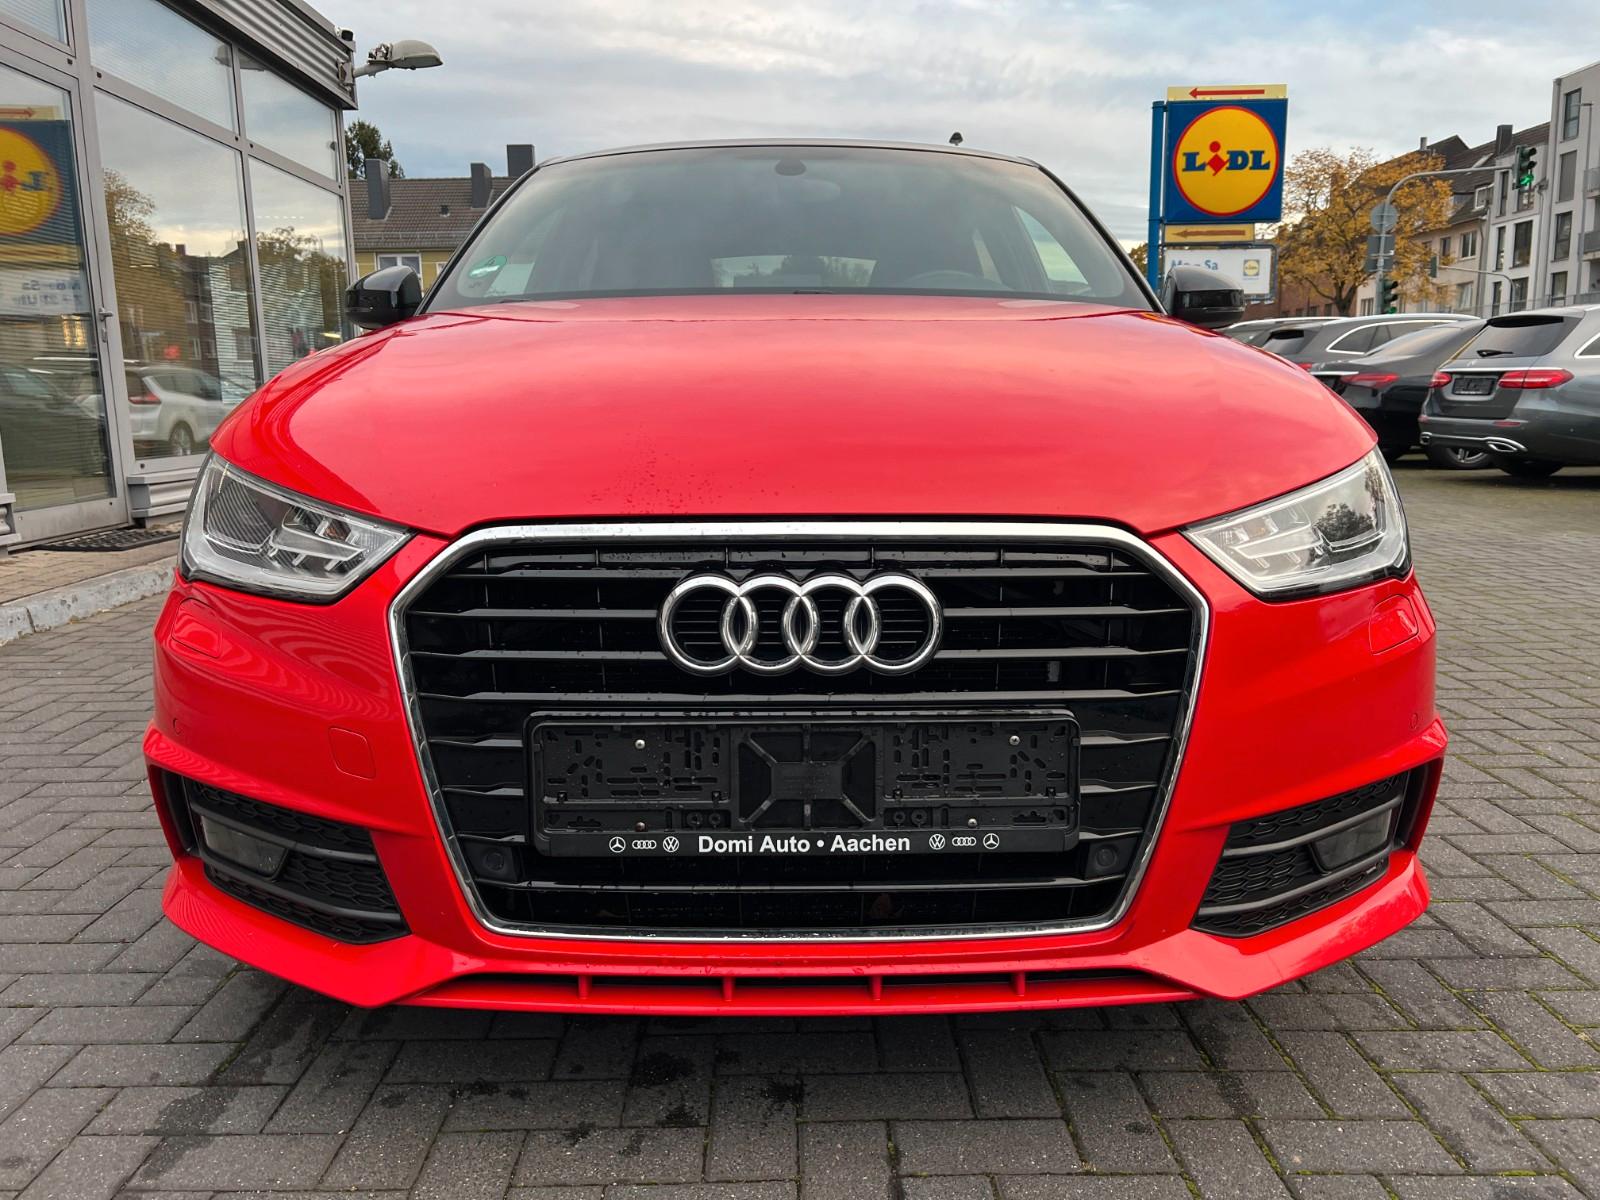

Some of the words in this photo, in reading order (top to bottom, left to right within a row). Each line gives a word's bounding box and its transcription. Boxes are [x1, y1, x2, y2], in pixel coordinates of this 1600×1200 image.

[698, 835, 753, 853] Domi
[759, 834, 811, 853] Auto
[830, 834, 911, 853] Aachen
